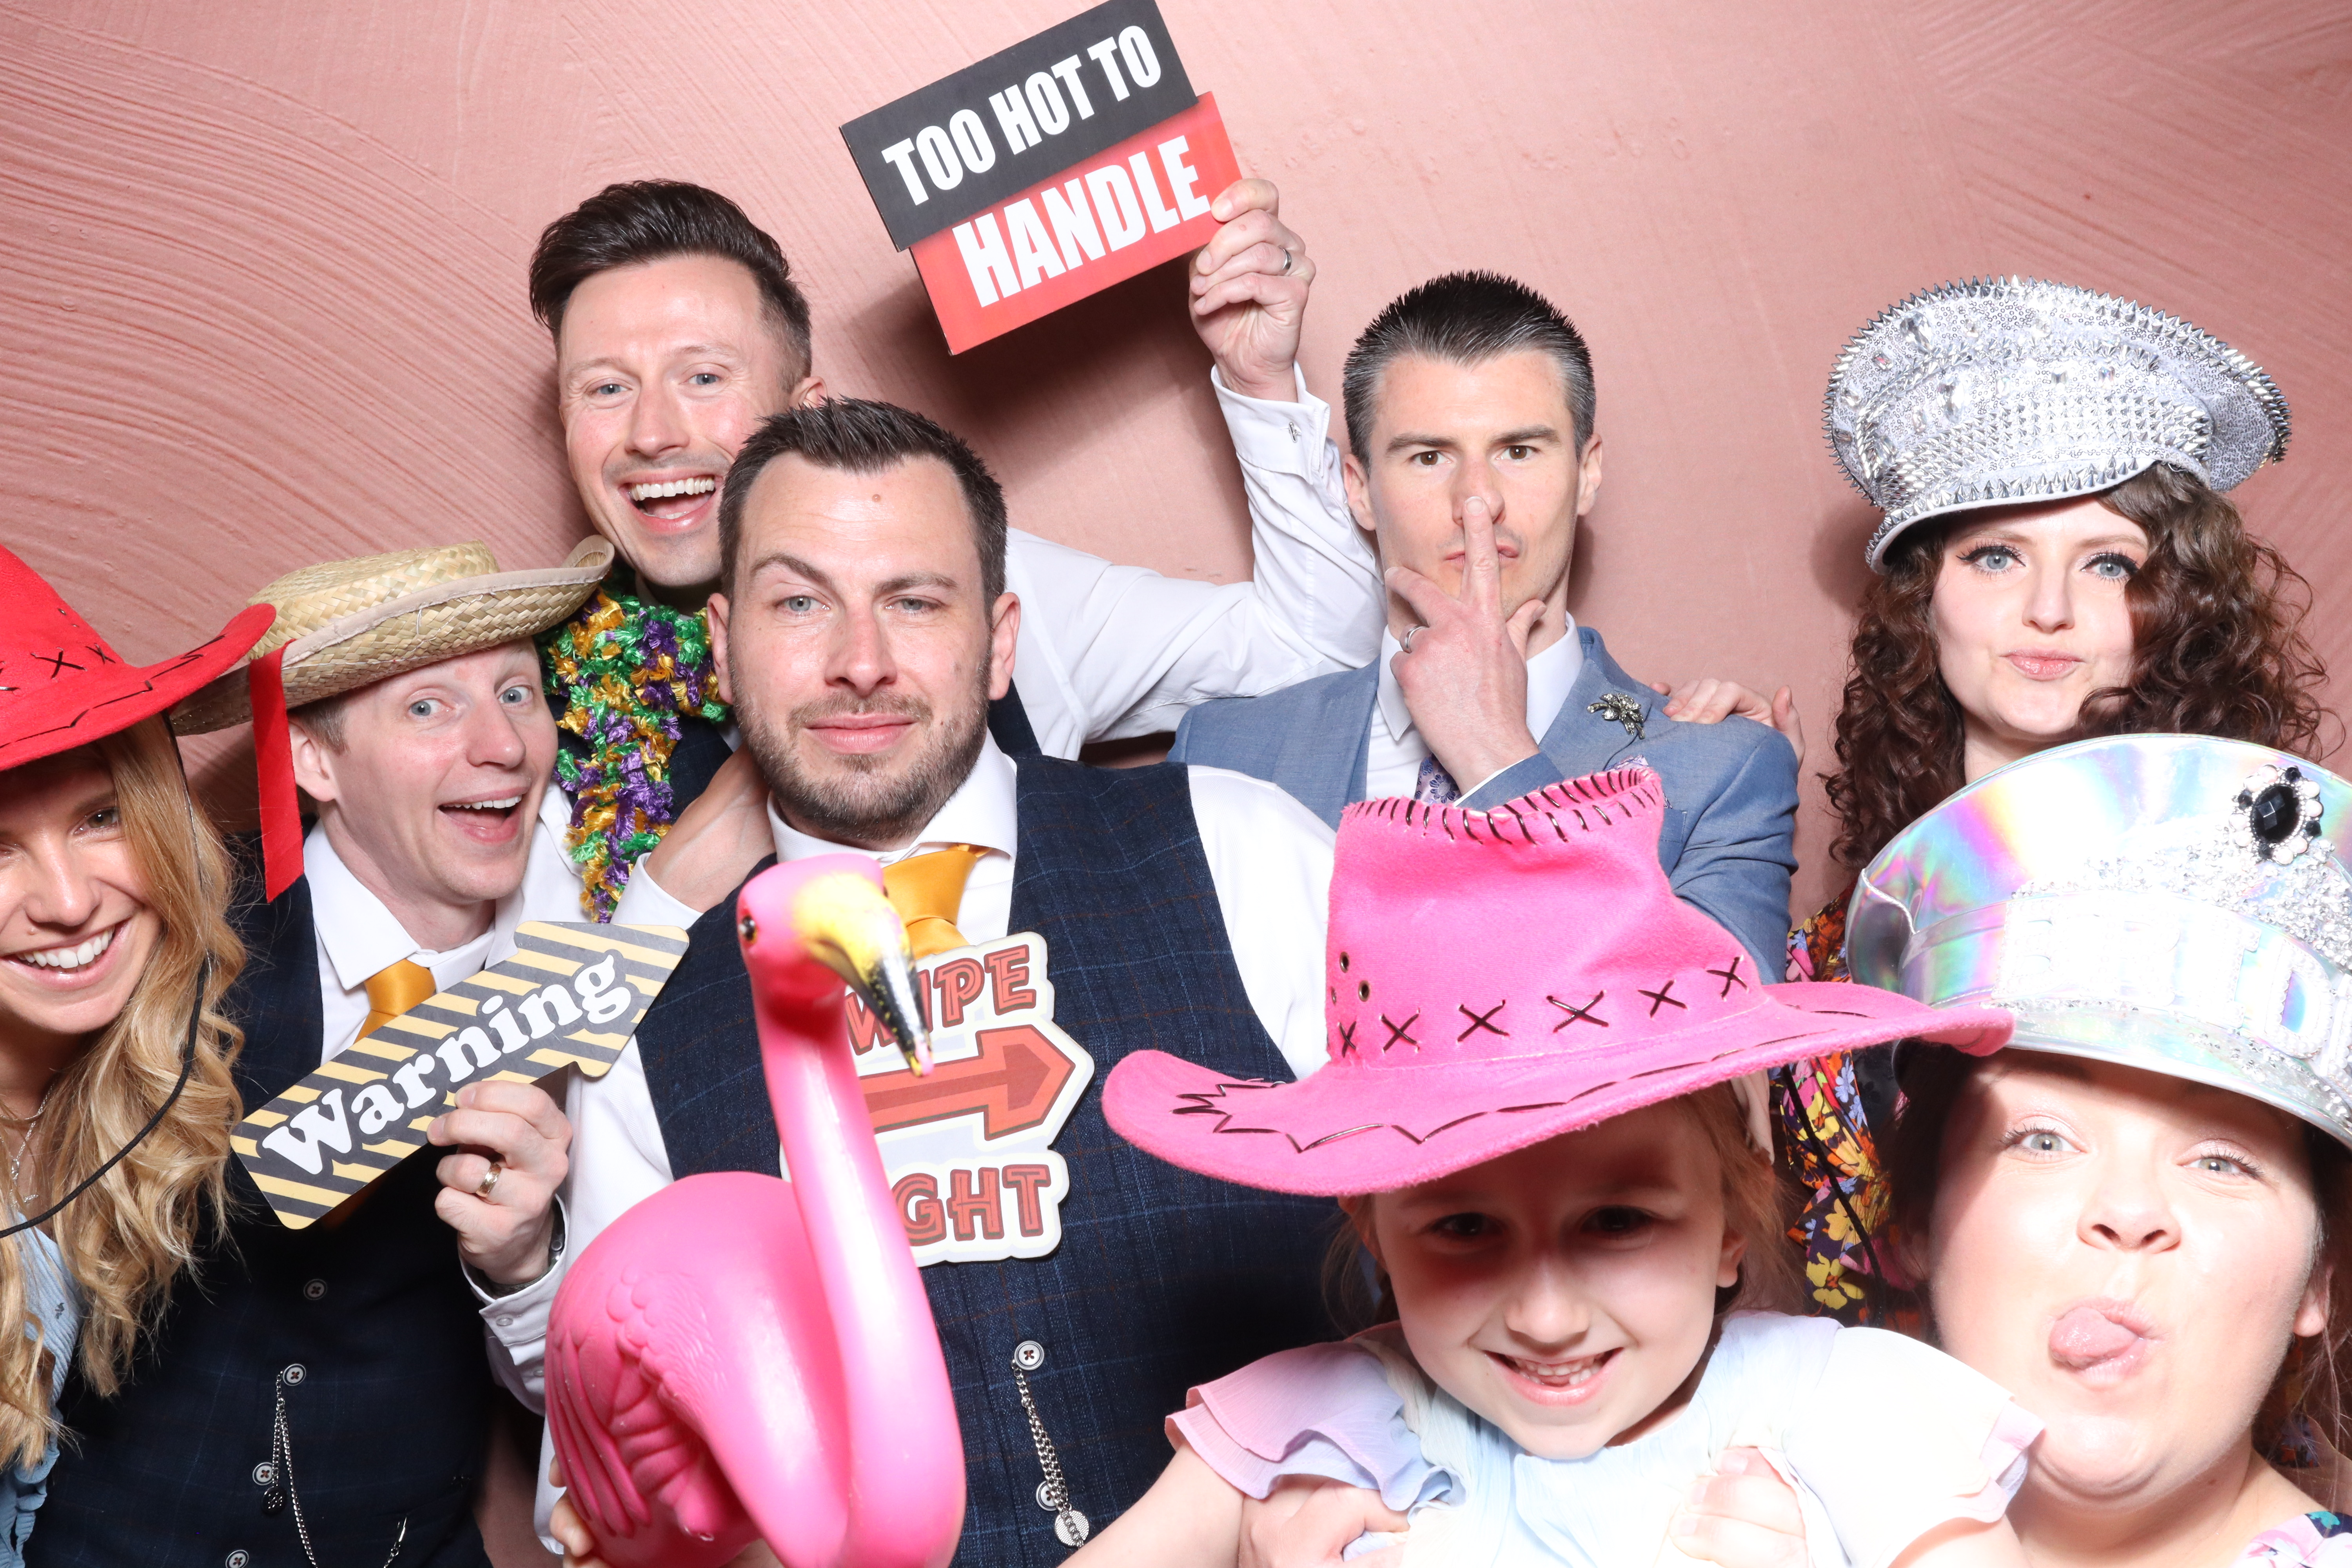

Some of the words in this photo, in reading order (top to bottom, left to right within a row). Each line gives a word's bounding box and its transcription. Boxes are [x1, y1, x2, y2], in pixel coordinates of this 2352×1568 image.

[881, 109, 996, 205] TOO
[989, 54, 1094, 155] HOT
[1087, 25, 1161, 102] TO
[952, 135, 1211, 308] HANDLE
[262, 955, 631, 1174] Warning
[891, 1164, 1051, 1246] GHT
